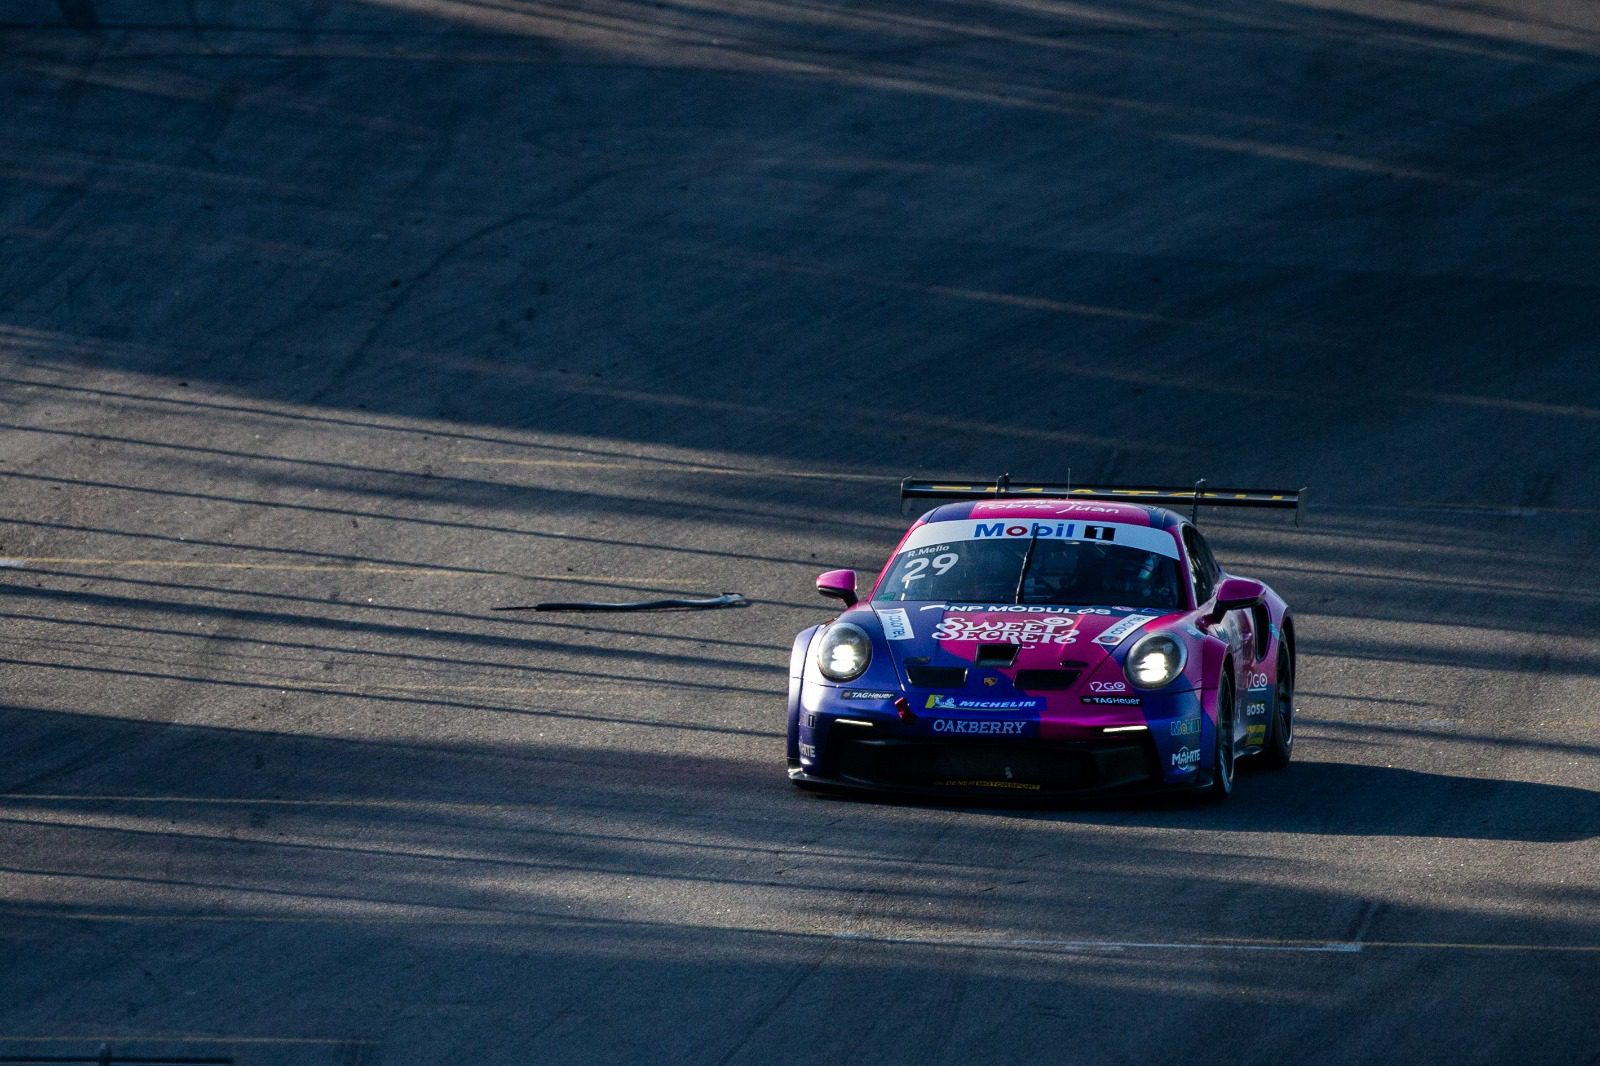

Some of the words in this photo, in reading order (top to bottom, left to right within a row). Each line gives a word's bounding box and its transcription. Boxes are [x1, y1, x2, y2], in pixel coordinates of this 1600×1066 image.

[974, 522, 1076, 539] Mobil
[907, 546, 950, 558] R.Mello
[902, 553, 959, 582] 29
[959, 700, 1037, 708] MICHELIN
[1246, 703, 1265, 716] BOSS
[933, 719, 1027, 734] OAKBERRY
